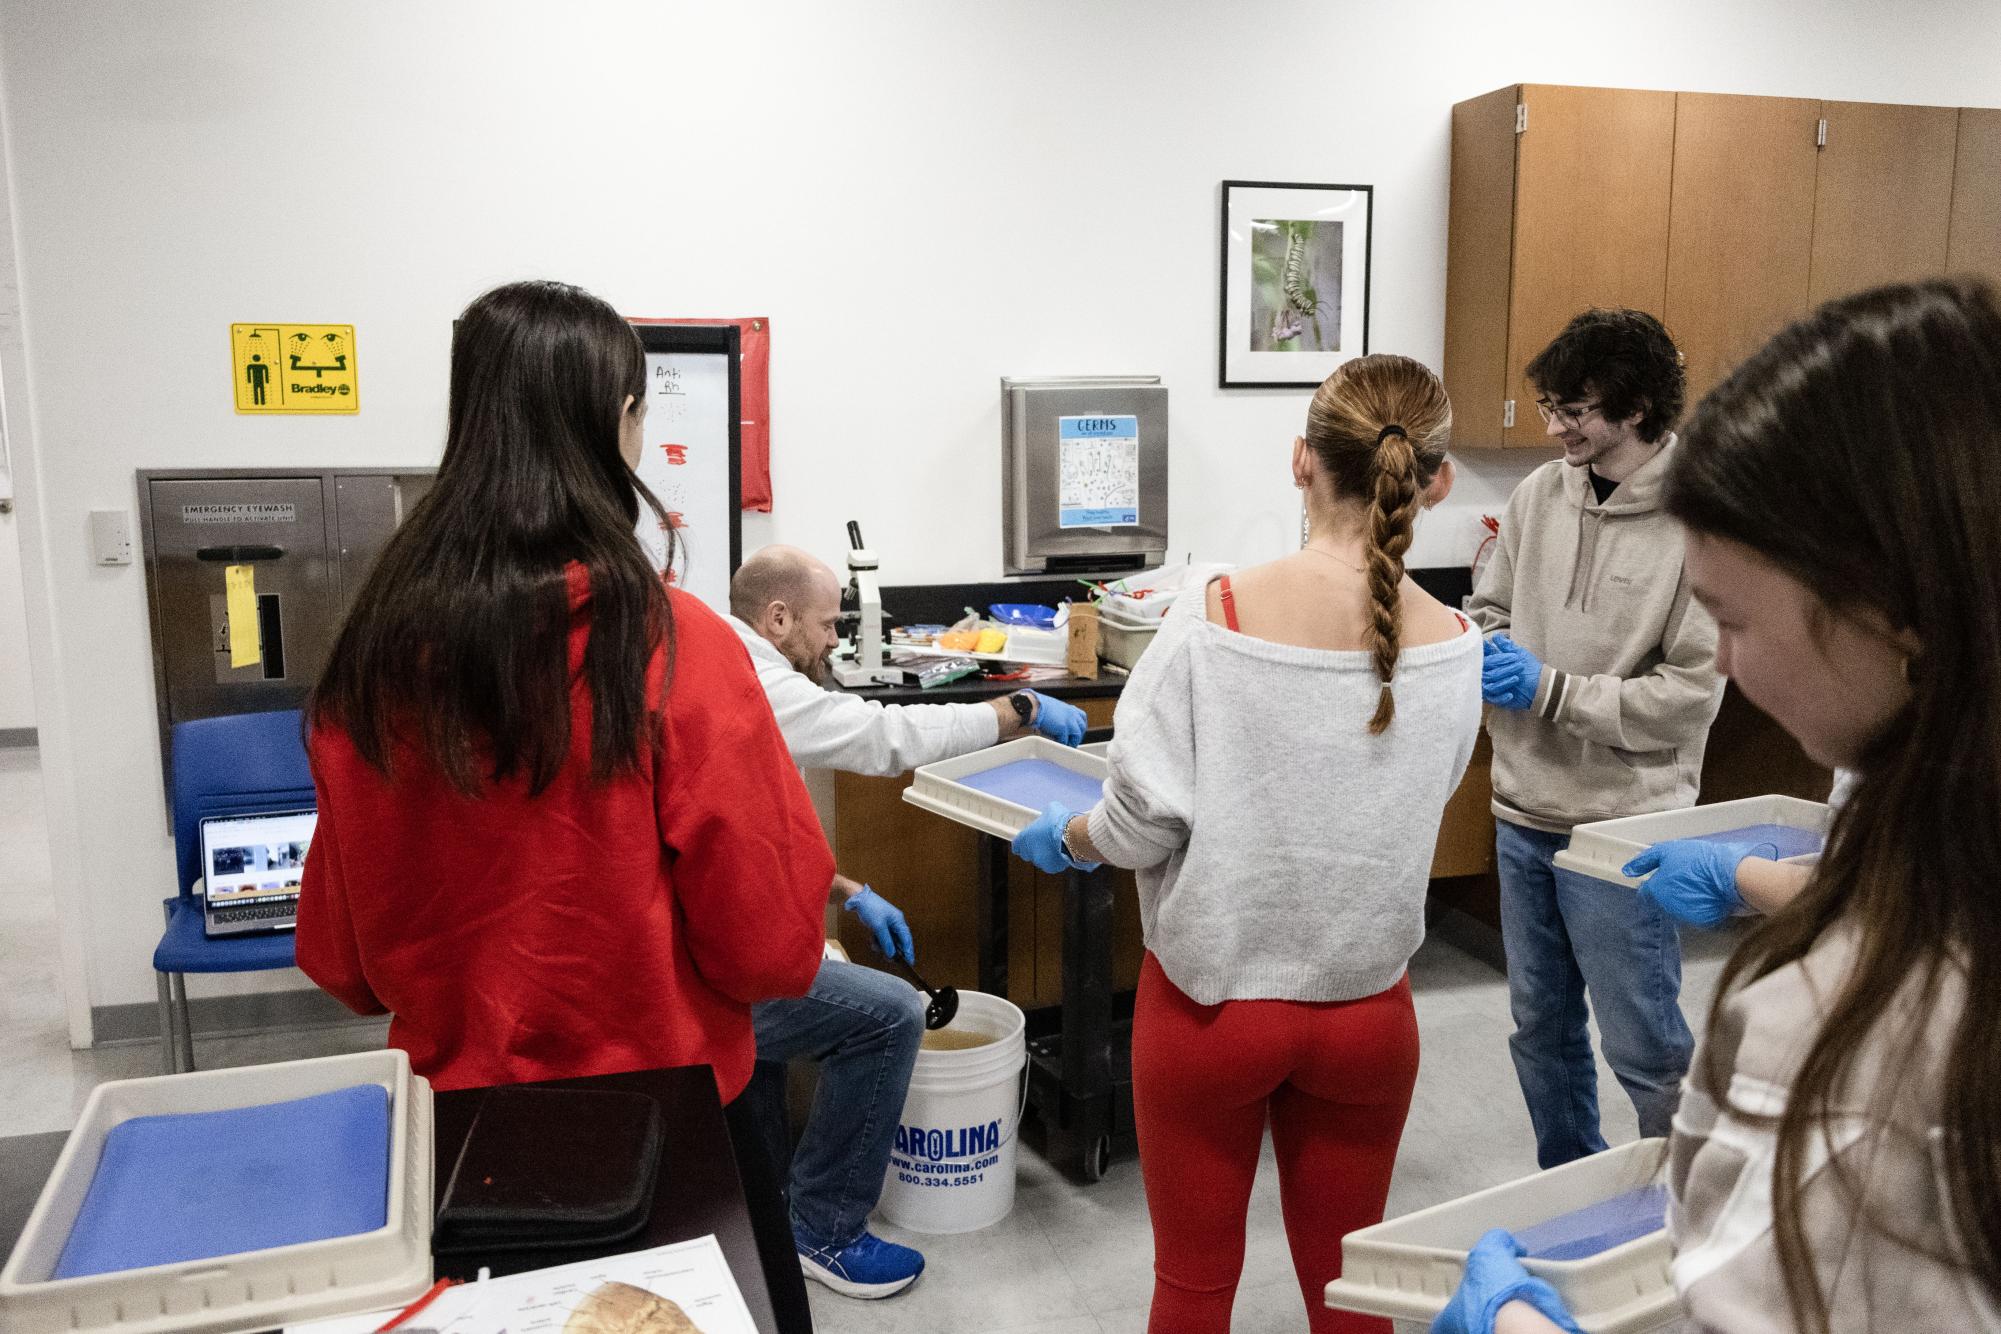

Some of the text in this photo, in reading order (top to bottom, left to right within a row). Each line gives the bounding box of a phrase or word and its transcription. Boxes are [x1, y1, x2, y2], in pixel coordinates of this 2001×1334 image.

[656, 366, 681, 379] Anti
[291, 383, 337, 395] Bradley
[664, 380, 680, 392] Rh
[184, 504, 293, 514] EMERGENCY EYEWASH
[894, 1121, 999, 1162] AROLINA
[889, 1155, 999, 1174] ww.carolina.com
[898, 1171, 984, 1188] 800.334.5551
